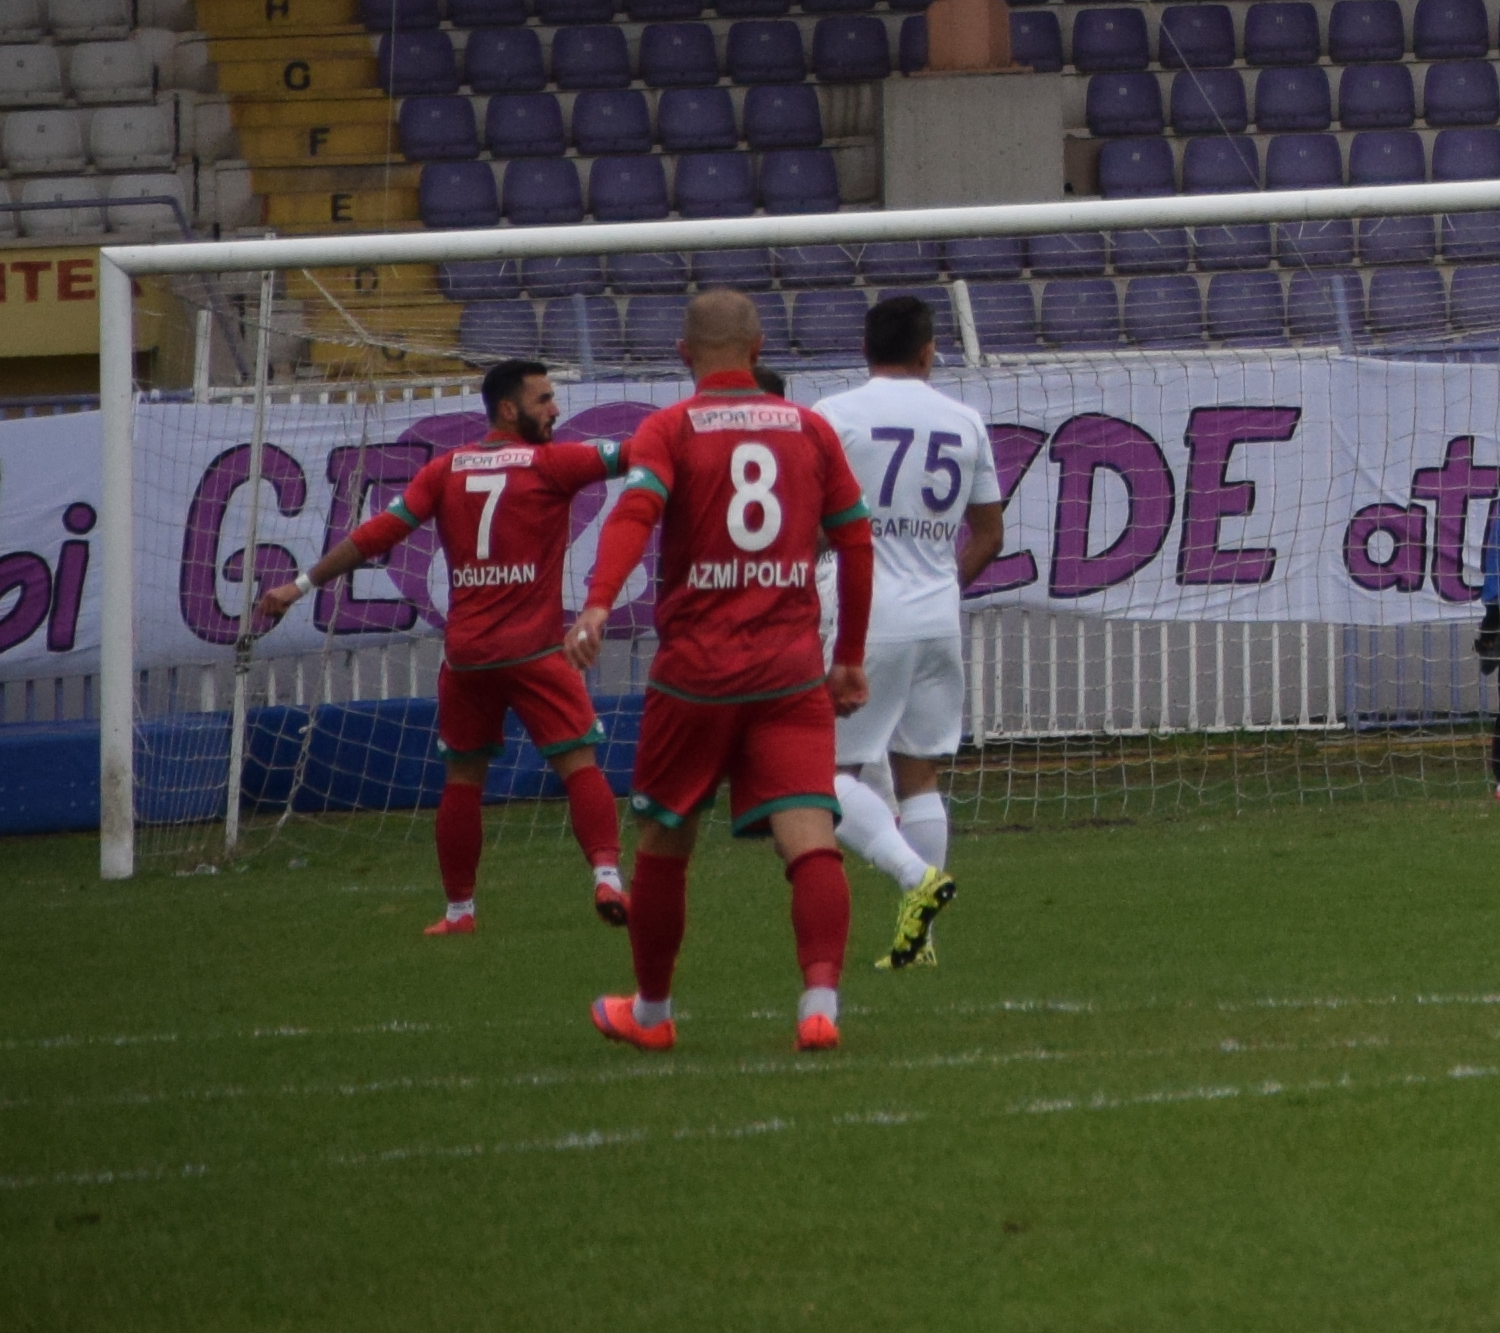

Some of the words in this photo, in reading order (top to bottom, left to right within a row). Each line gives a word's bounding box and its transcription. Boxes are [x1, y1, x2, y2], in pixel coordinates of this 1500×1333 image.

[310, 127, 330, 155] F
[331, 194, 353, 222] E
[871, 426, 962, 513] 75
[726, 441, 782, 552] 8
[465, 474, 507, 560] 7
[453, 563, 535, 587] OĞUZHAN
[687, 559, 738, 590] AZMİ
[744, 561, 809, 589] POLAT
